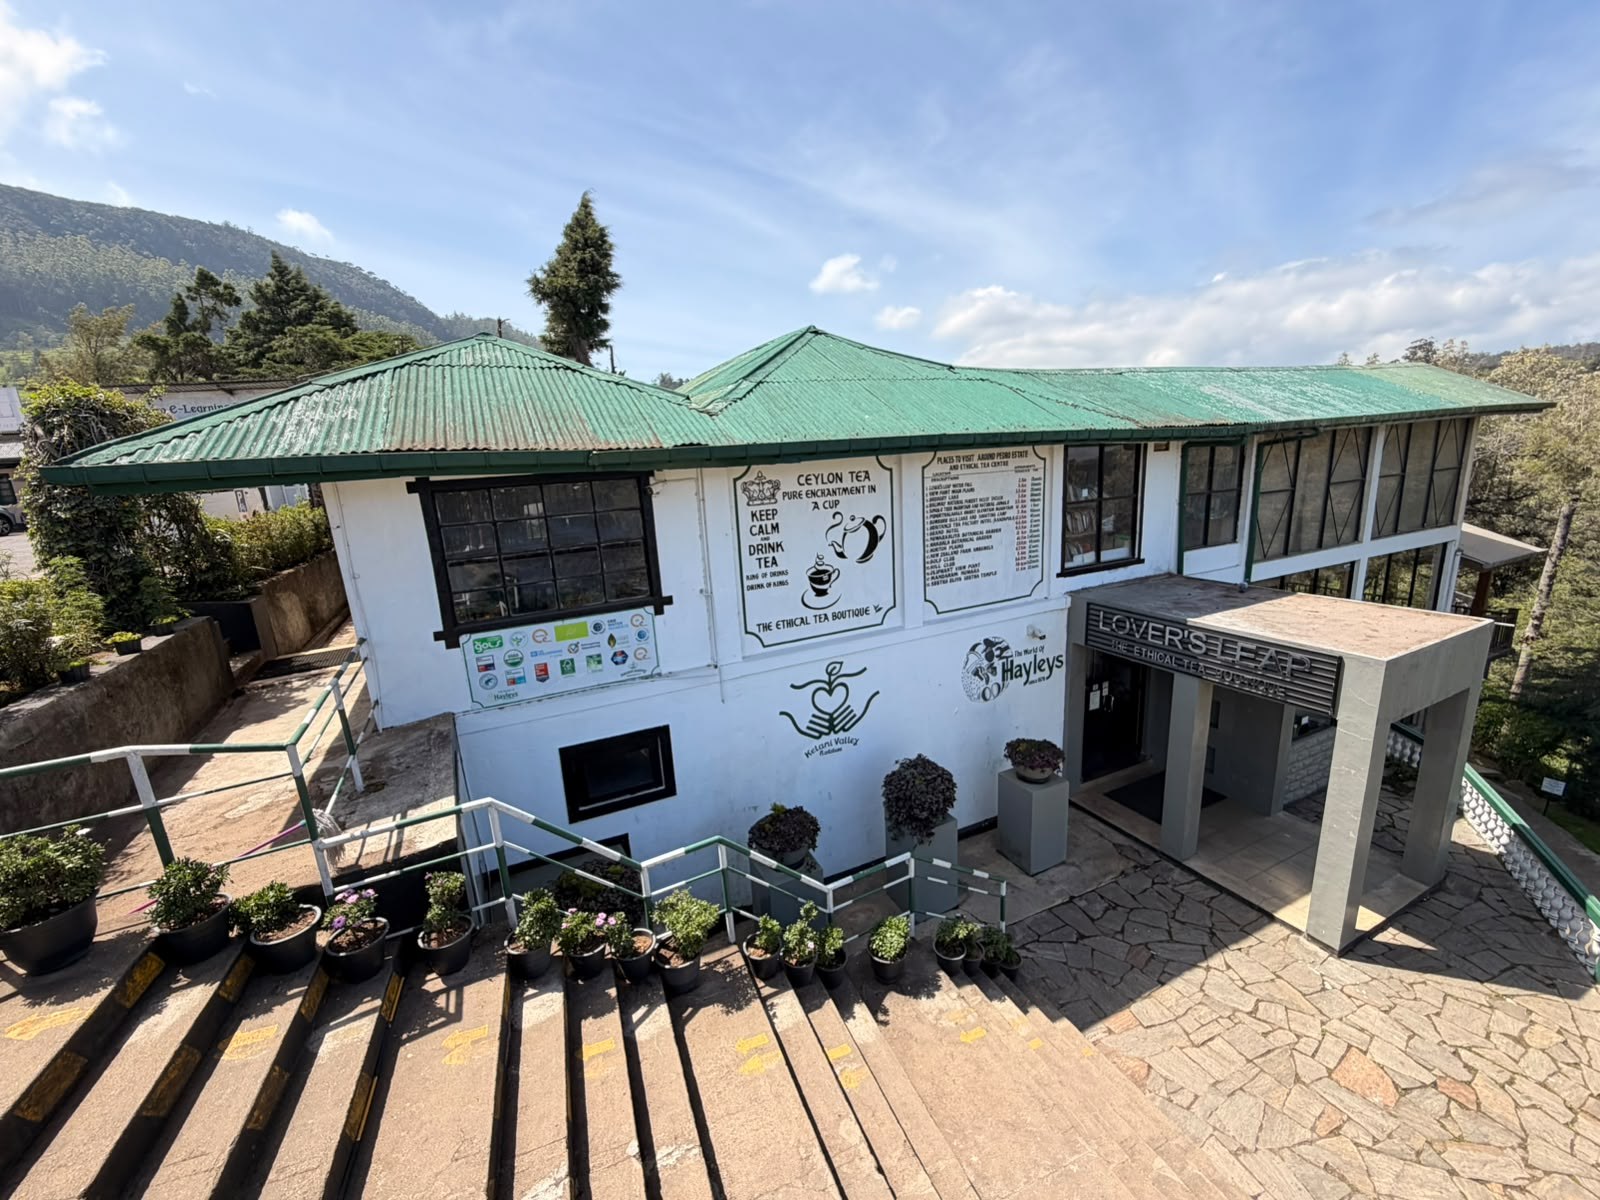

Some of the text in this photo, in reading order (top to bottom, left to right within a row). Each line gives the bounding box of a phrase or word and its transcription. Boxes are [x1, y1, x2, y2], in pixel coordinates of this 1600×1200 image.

[169, 402, 230, 414] e-Learnin
[937, 455, 955, 464] PLACES
[955, 455, 961, 463] TO
[962, 454, 975, 463] VISIT
[977, 453, 996, 461] AROUND
[1011, 450, 1029, 459] ESTATE
[797, 470, 871, 486] CEYLON TEA
[782, 485, 876, 501] PURE ENCHANTMENT IN
[811, 499, 840, 511] A CUP
[750, 508, 778, 522] KEEP
[749, 522, 779, 537] CALM
[748, 541, 785, 556] DRINK
[755, 556, 778, 569] TEA
[746, 573, 759, 581] KING
[770, 569, 789, 578] DRINKS
[746, 579, 789, 591] DRINK OF KINGS
[756, 606, 870, 633] THE ETHICAL TEA BOUTIQUE
[1099, 610, 1311, 678] LOVER'S LEAP
[1001, 654, 1064, 687] Hayleys
[1111, 639, 1286, 697] THE ETHICAL TEA BOUTIQUE
[804, 736, 859, 758] Kelani Valley
